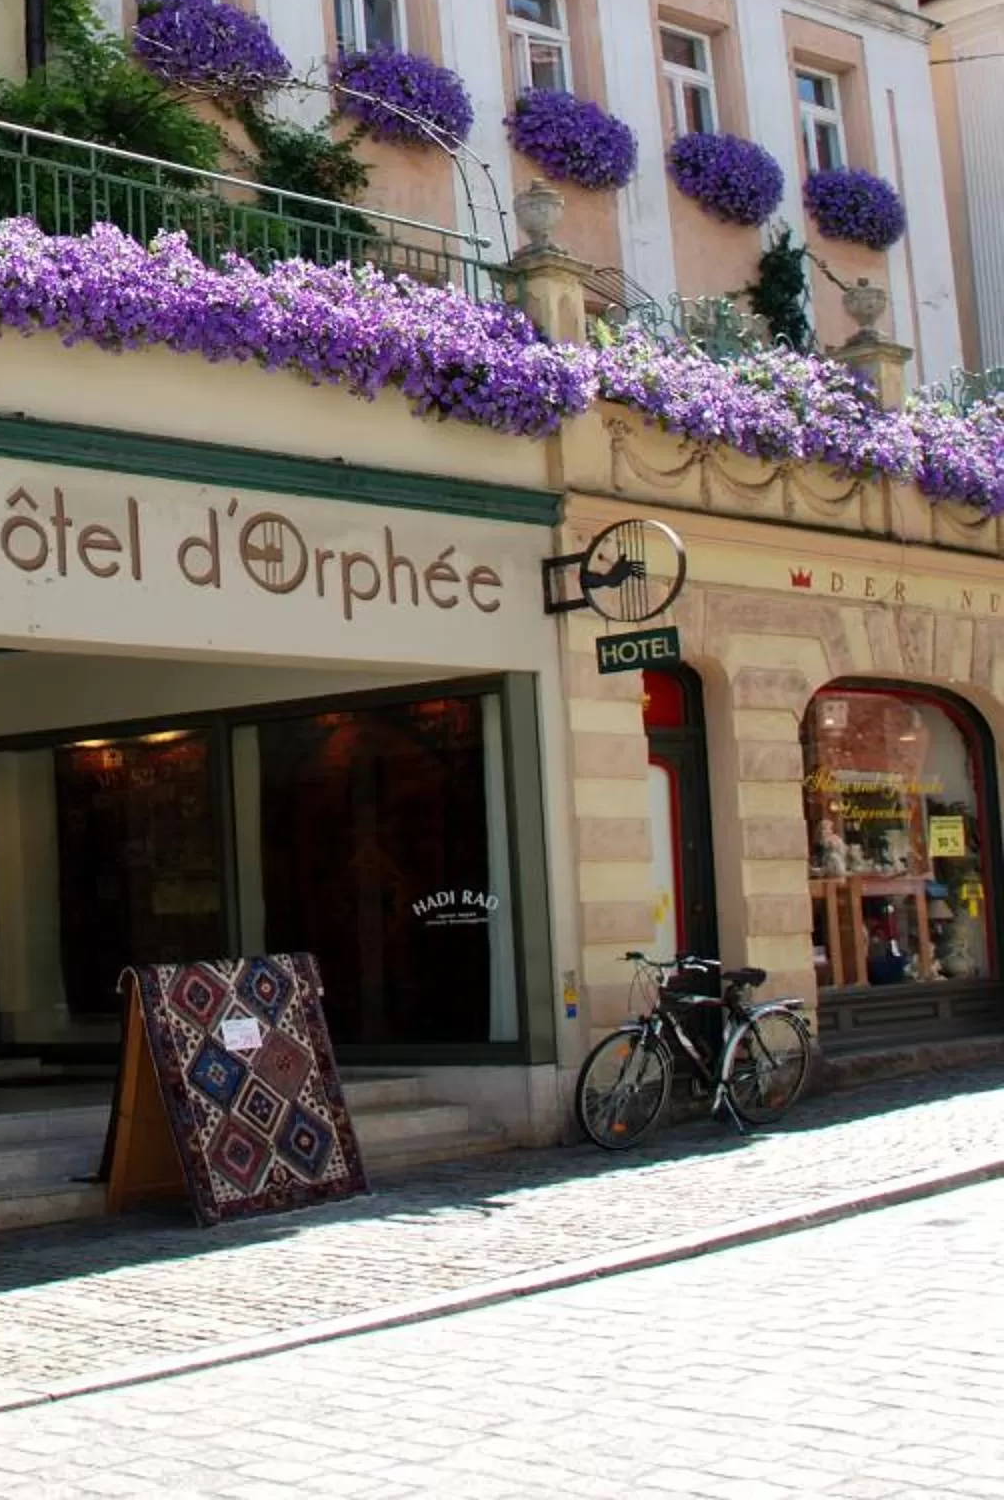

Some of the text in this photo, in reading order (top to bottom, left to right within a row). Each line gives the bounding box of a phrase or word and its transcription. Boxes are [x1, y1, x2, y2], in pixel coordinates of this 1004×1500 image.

[176, 498, 503, 621] d'Orphée
[831, 571, 906, 603] DER
[601, 636, 677, 668] HOTEL
[412, 889, 499, 916] HADI RAD
